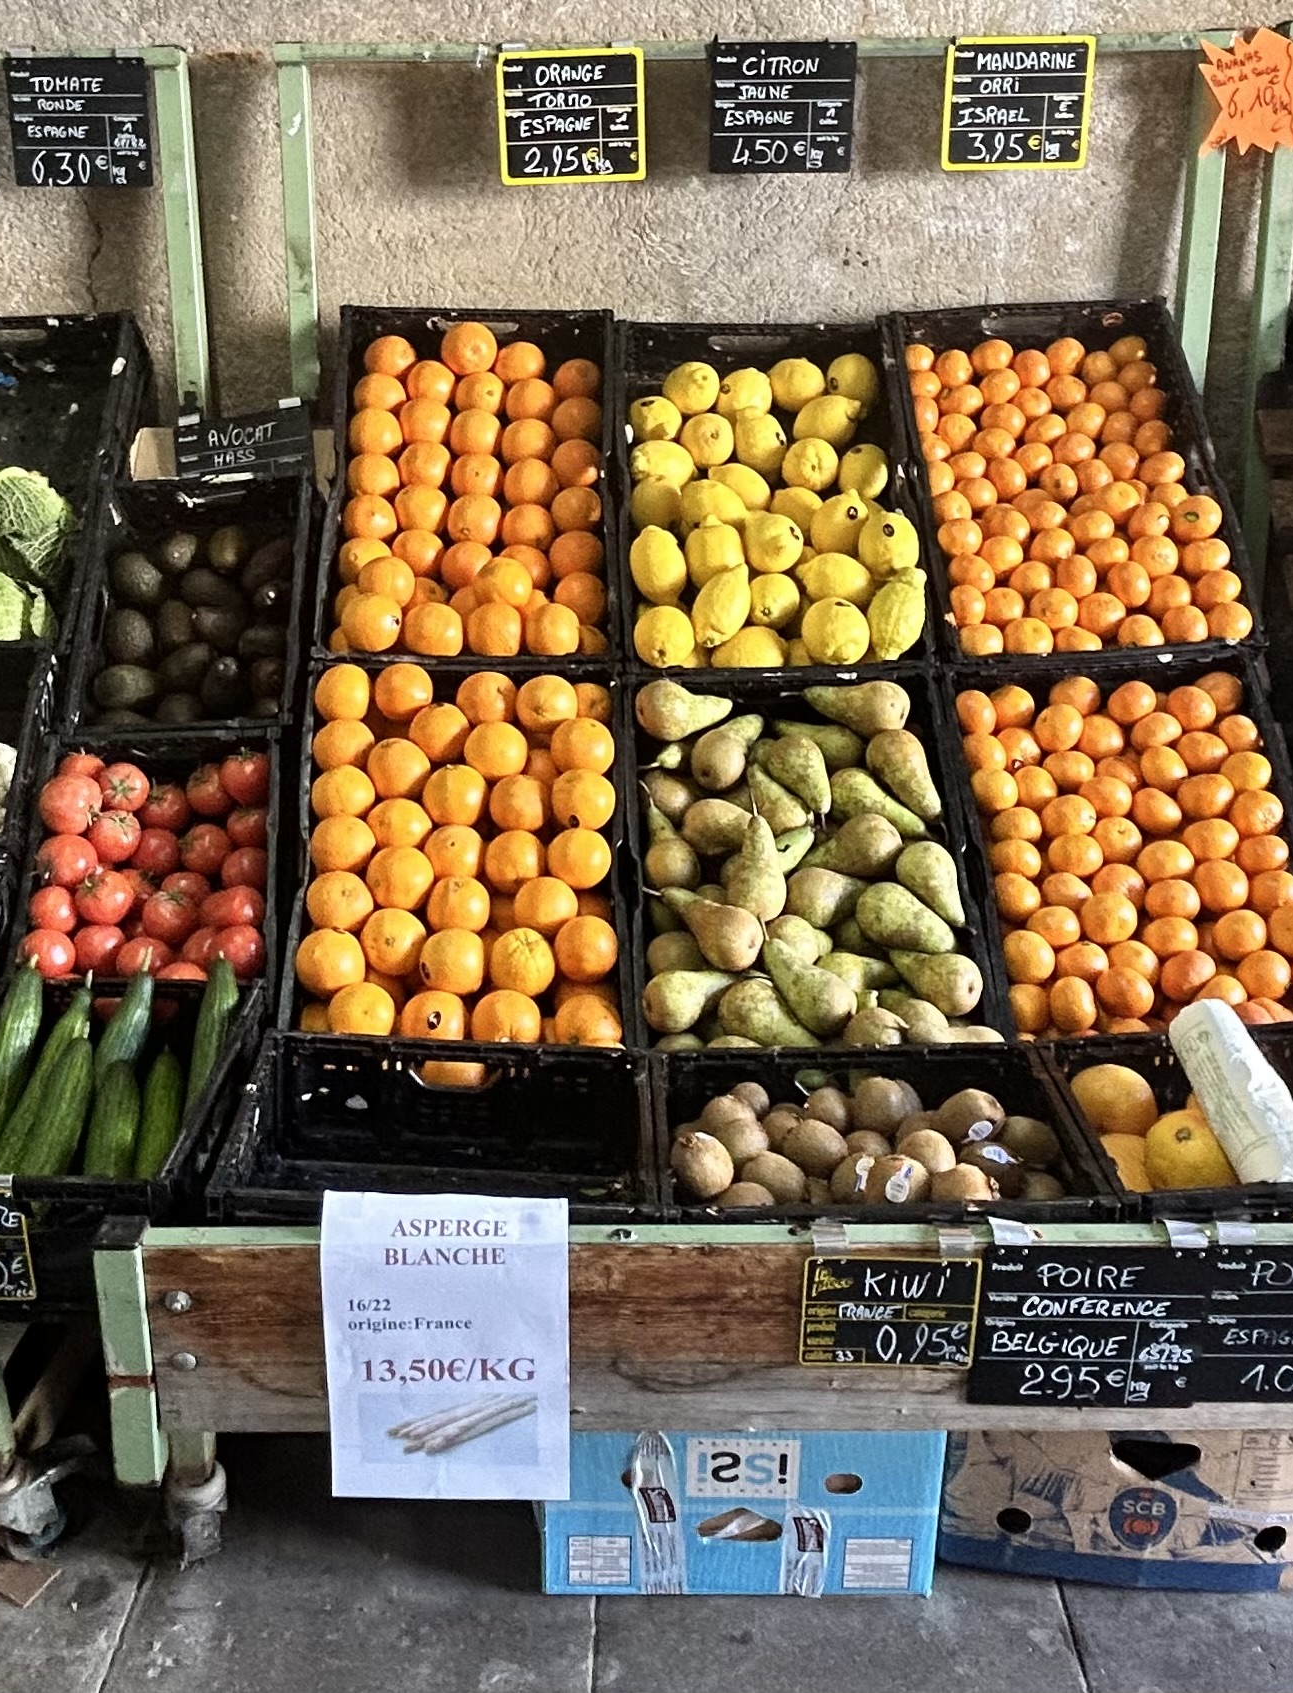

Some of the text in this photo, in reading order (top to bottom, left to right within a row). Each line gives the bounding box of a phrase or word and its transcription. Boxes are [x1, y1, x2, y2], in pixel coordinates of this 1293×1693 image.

[743, 49, 819, 76] CITRON
[977, 51, 1077, 71] MANDARINE
[1216, 51, 1263, 72] ANANAS
[535, 63, 606, 86] ORANGE
[29, 76, 104, 93] TOMATE
[738, 85, 793, 100] JAUNE
[37, 98, 86, 111] RONDE
[724, 110, 795, 127] ESPAGNE
[957, 106, 1030, 126] ISRAEL
[27, 125, 89, 138] ESPAGNE
[520, 115, 595, 138] ESPAGNE
[793, 141, 807, 156] €
[967, 132, 1041, 162] 3,95 €
[32, 150, 90, 187] 6,30
[524, 145, 578, 176] 2,95
[208, 421, 278, 447] AVOCAT
[214, 449, 256, 468] HASS
[391, 1219, 508, 1238] ASPERGE
[11, 1257, 24, 1274] €
[385, 1247, 506, 1266] BLANCHE
[864, 1267, 951, 1298] KIWI
[1037, 1263, 1145, 1290] POIRE
[347, 1298, 391, 1312] 16/22
[839, 1303, 902, 1320] FRANCE
[1022, 1296, 1171, 1317] CONFERENCE
[348, 1317, 472, 1333] origine:France
[992, 1330, 1127, 1359] BELGIQUE
[835, 1351, 854, 1362] 33
[362, 1358, 536, 1386] 13,50€/KG
[1105, 1369, 1127, 1387] €
[1123, 1500, 1167, 1516] SCB
